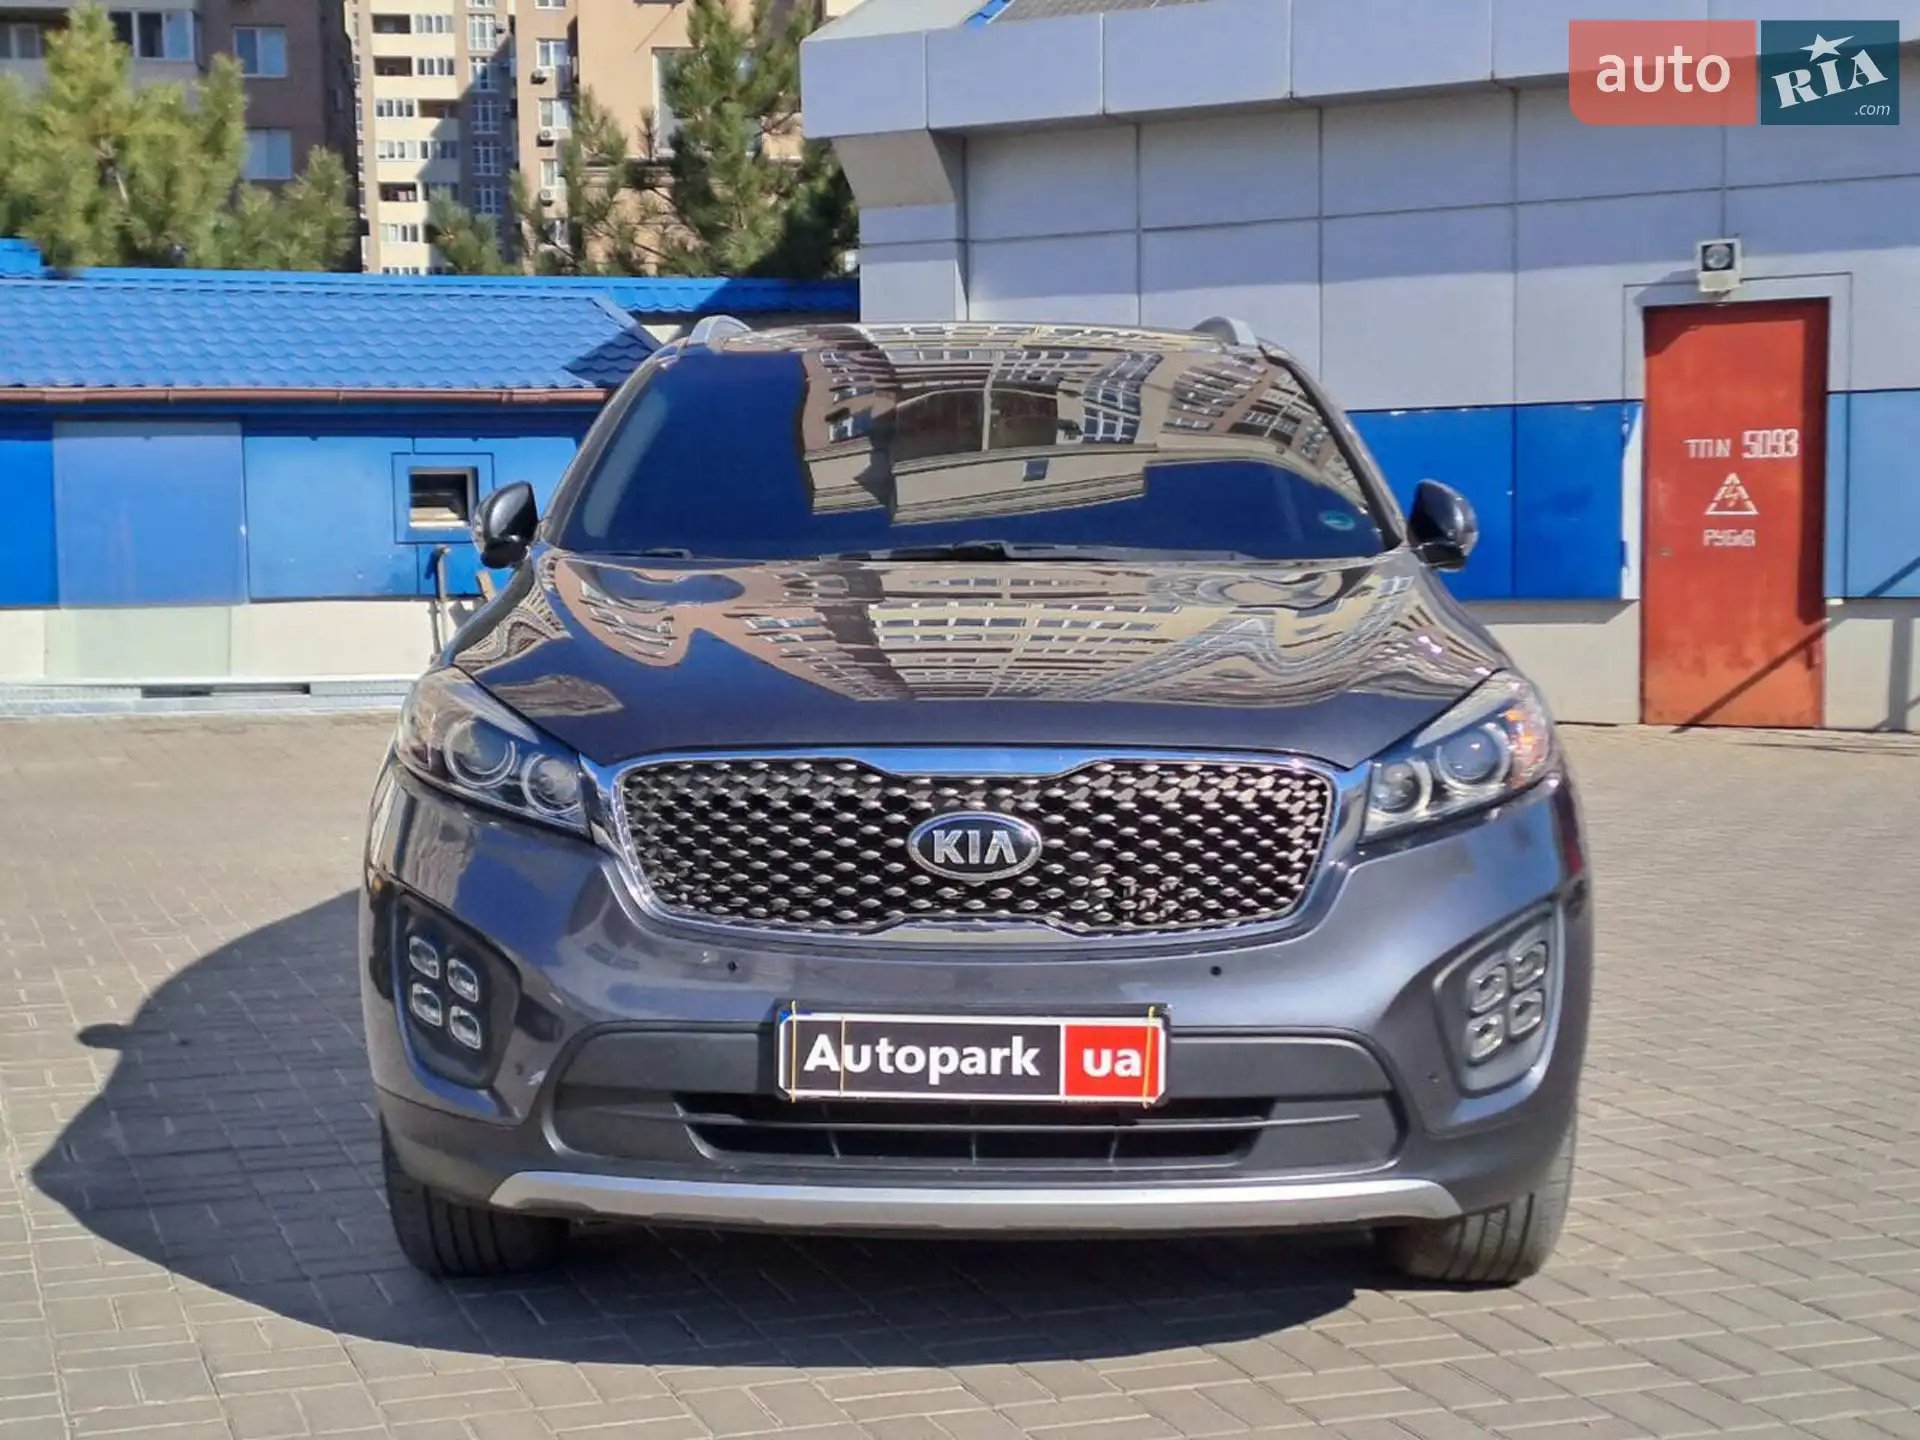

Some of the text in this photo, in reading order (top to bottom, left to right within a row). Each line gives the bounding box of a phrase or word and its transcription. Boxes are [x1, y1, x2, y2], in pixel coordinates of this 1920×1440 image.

[1741, 428, 1799, 459] 5093
[932, 830, 1018, 865] KIA
[804, 1033, 1142, 1085] Autopark ua
